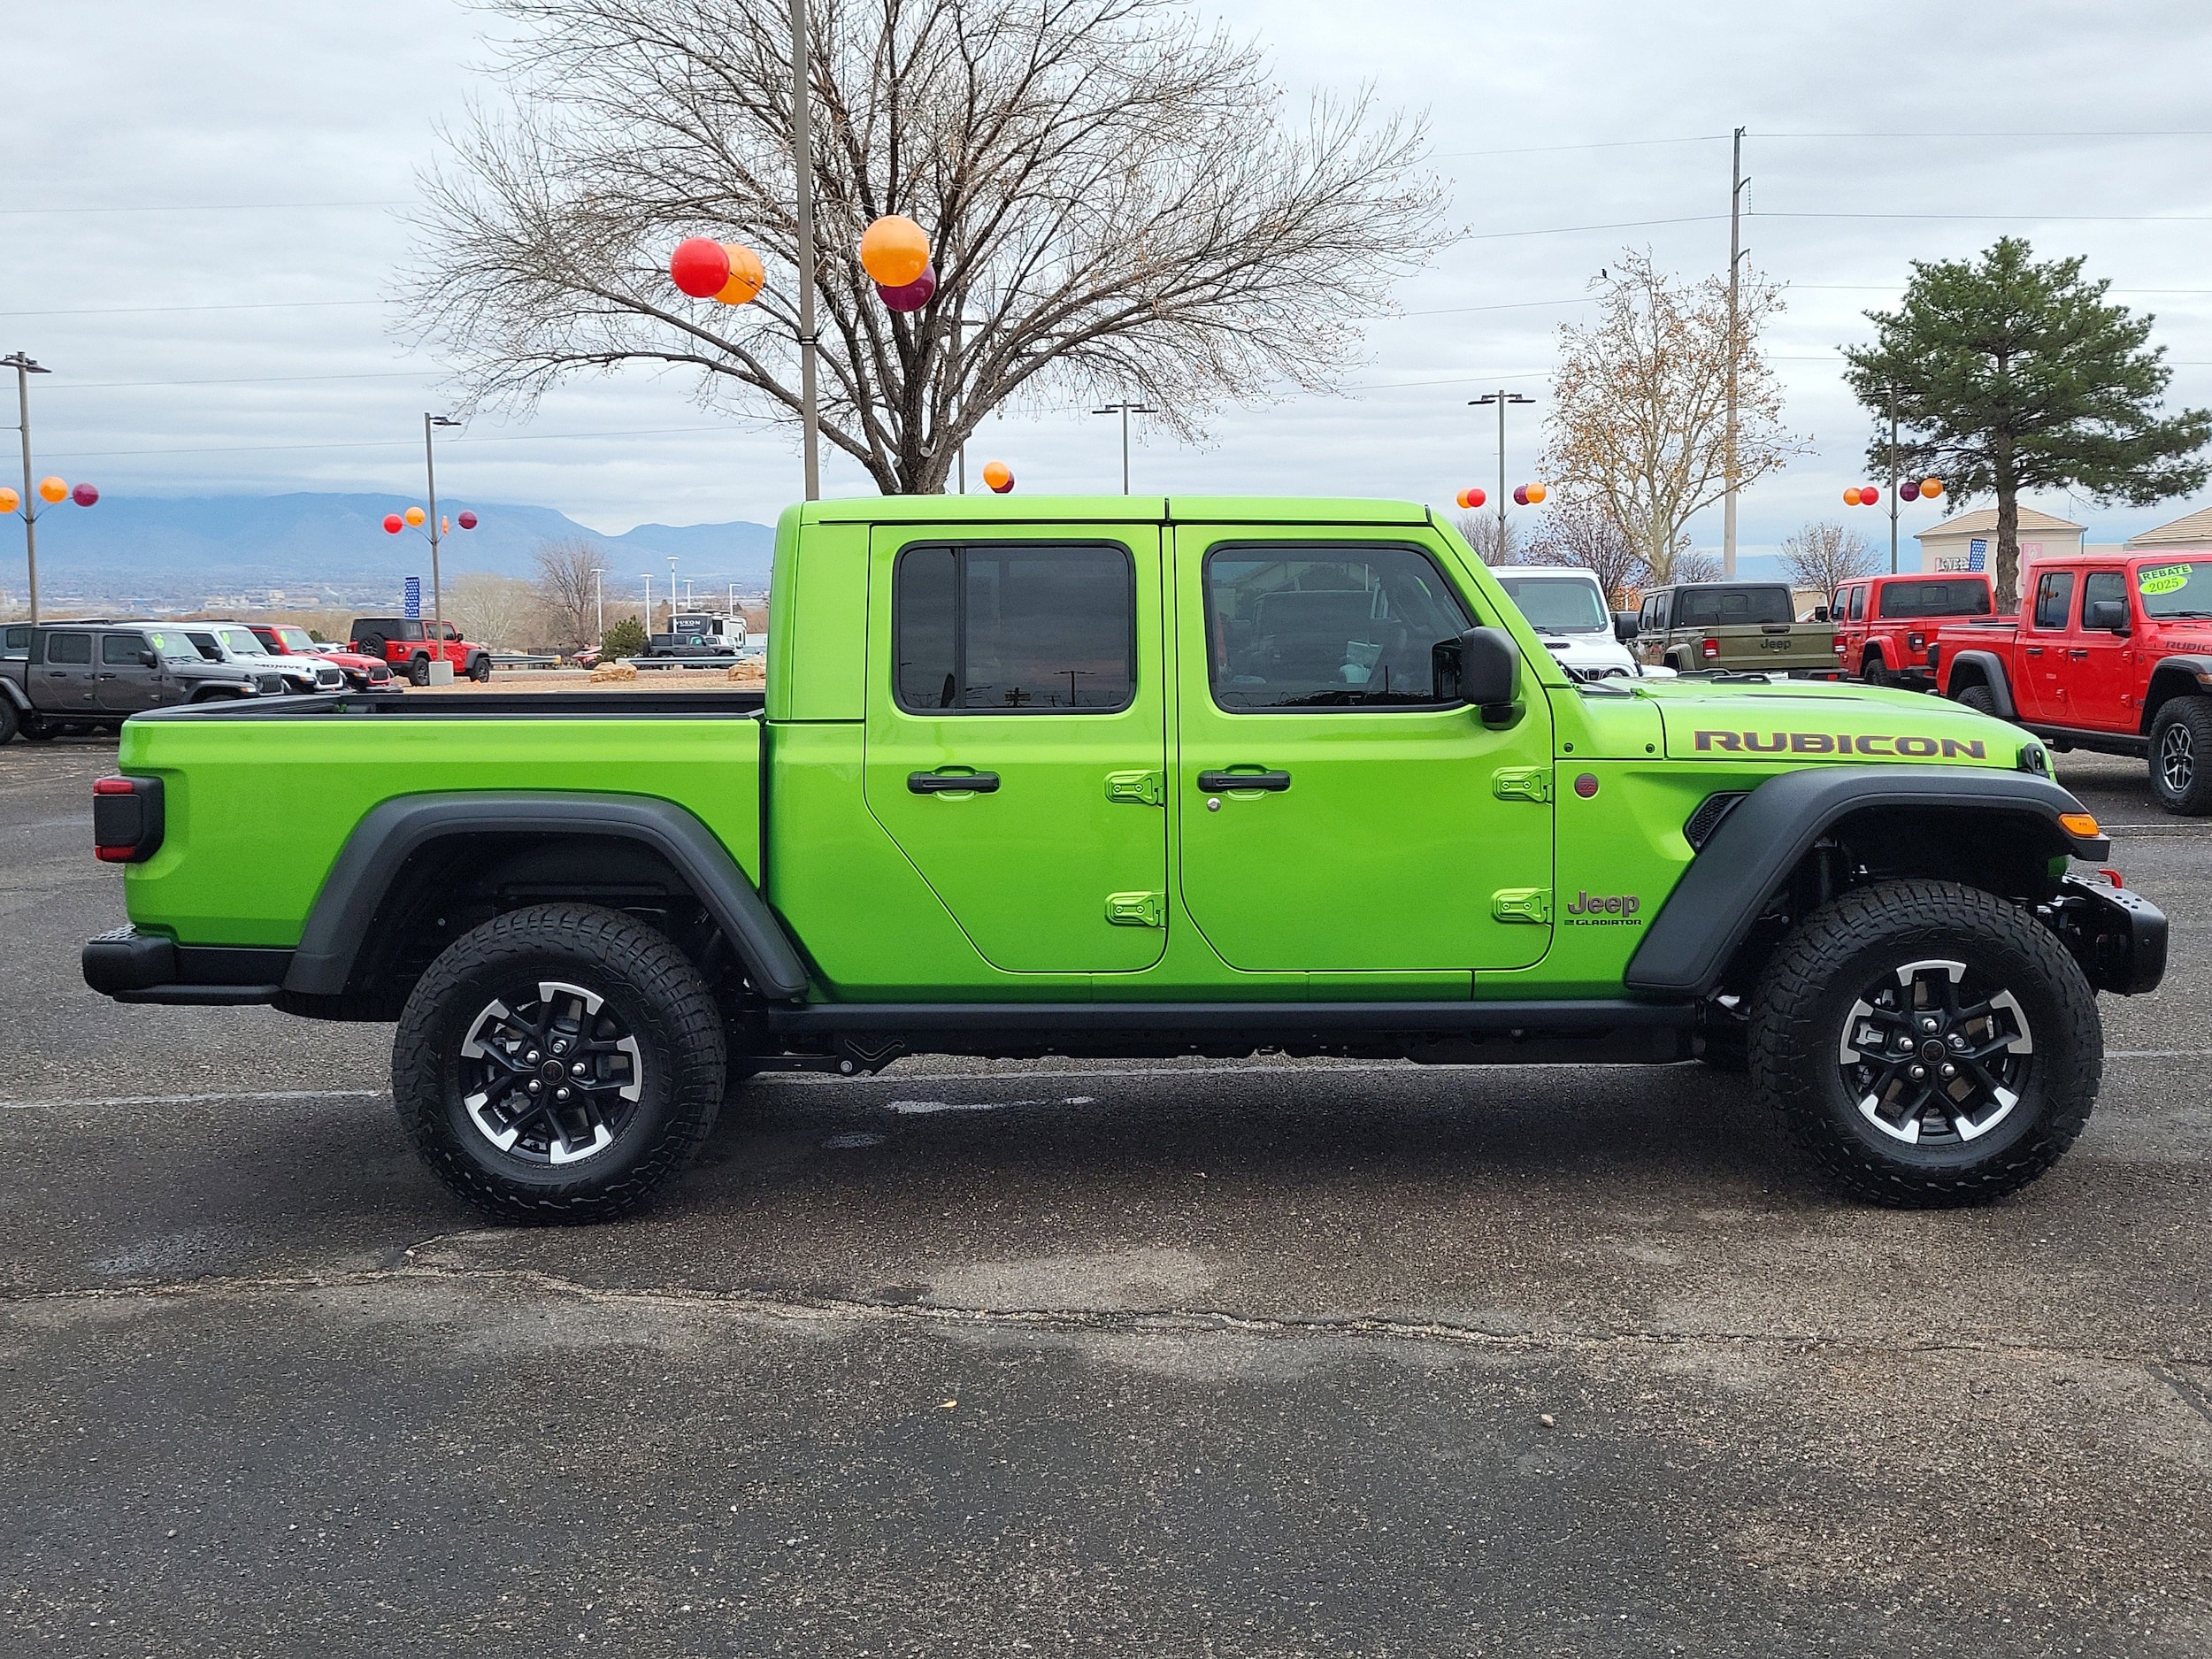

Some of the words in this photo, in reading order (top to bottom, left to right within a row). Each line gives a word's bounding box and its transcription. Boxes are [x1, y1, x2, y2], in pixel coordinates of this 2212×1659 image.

[2142, 565, 2190, 580] REBATE
[2149, 578, 2179, 593] 2025
[1761, 639, 1792, 649] Jeep
[2165, 641, 2212, 651] RUBIC
[1694, 731, 1987, 759] RUBICON
[1568, 890, 1640, 918] Jeep
